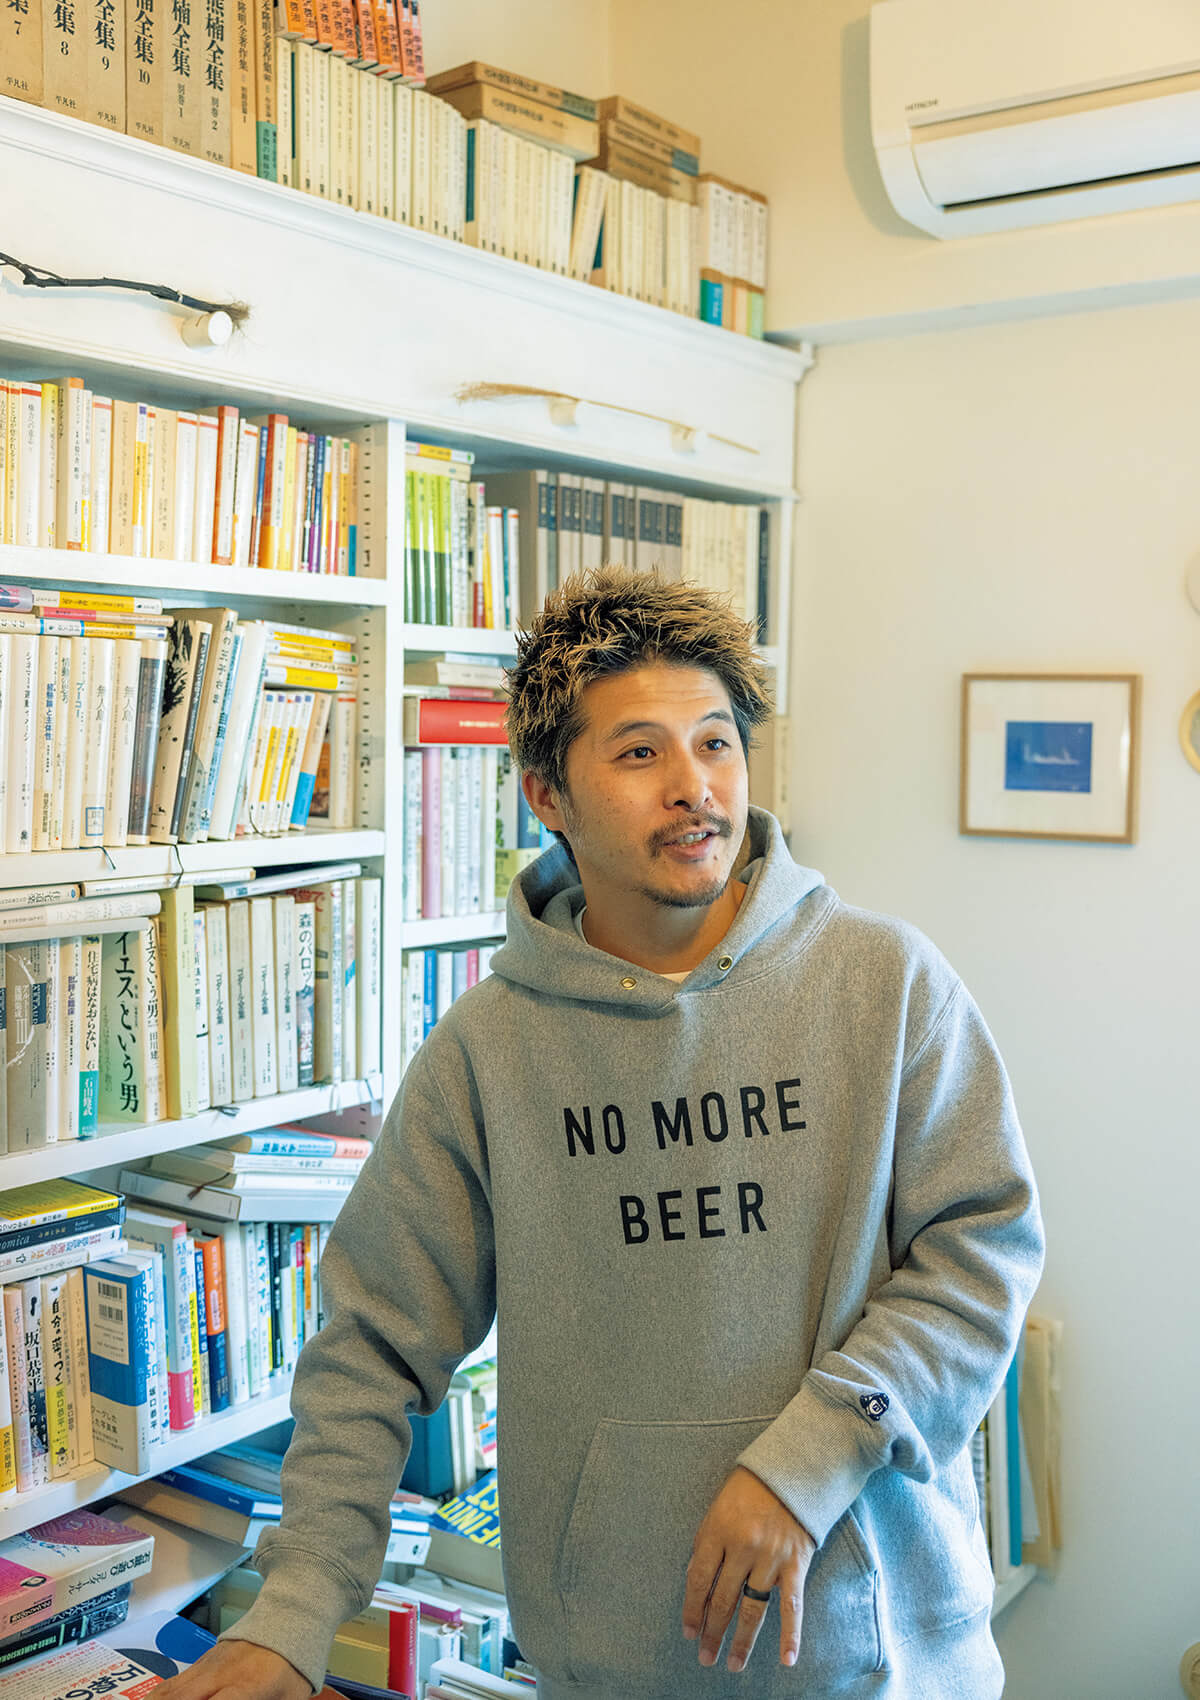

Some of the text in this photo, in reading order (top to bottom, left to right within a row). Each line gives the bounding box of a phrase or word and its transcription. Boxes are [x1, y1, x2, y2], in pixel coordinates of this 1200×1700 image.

[14, 20, 23, 35] 7
[53, 0, 75, 56] 集 8
[172, 0, 190, 77] 楠全集
[6, 77, 29, 91] 平凡社
[102, 56, 110, 71] 9
[138, 69, 150, 85] 10
[56, 95, 77, 109] 平凡社
[145, 927, 159, 1019] イエスという男
[298, 913, 315, 1000] 森のバロック
[86, 951, 98, 1051] 住宅病はなおらない
[115, 932, 139, 1113] イエスという男
[563, 1078, 807, 1157] NO MORE
[619, 1181, 767, 1245] BEER
[24, 1328, 42, 1393] 坂口恭平
[52, 1663, 147, 1700] 万物の
